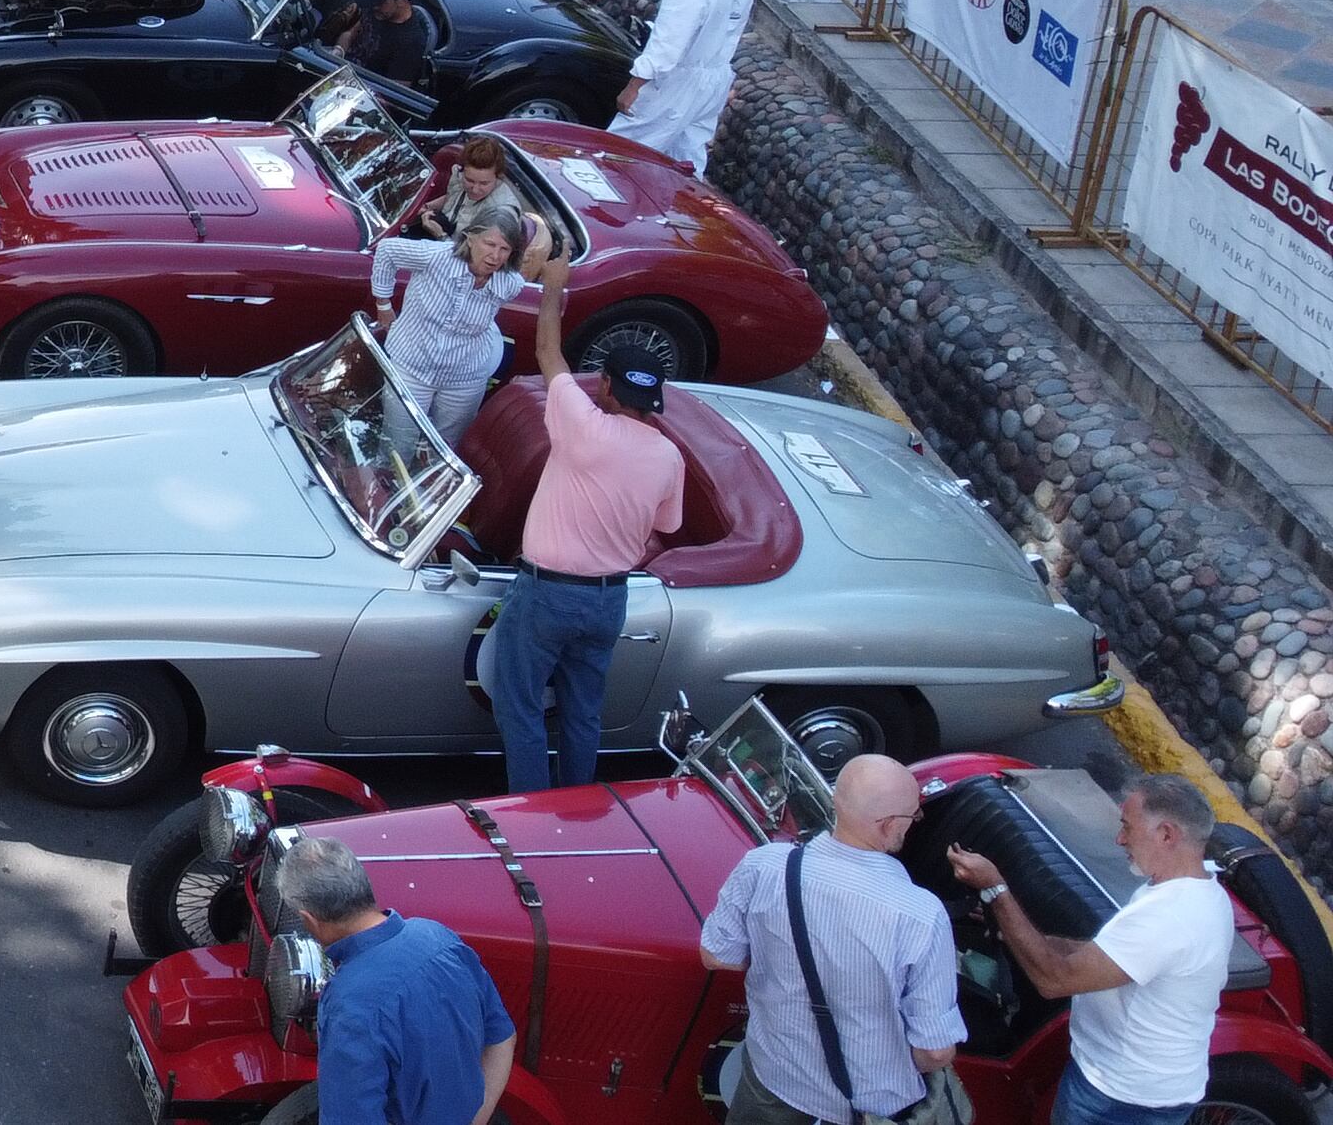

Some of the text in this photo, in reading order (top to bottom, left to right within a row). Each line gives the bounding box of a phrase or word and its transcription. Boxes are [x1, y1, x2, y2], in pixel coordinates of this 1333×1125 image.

[1222, 146, 1266, 191] LAS
[1265, 134, 1327, 182] RALLY
[1188, 216, 1217, 247] COPA
[1222, 243, 1254, 272] PARK
[1260, 263, 1300, 306] HYATT
[800, 453, 838, 469] 11
